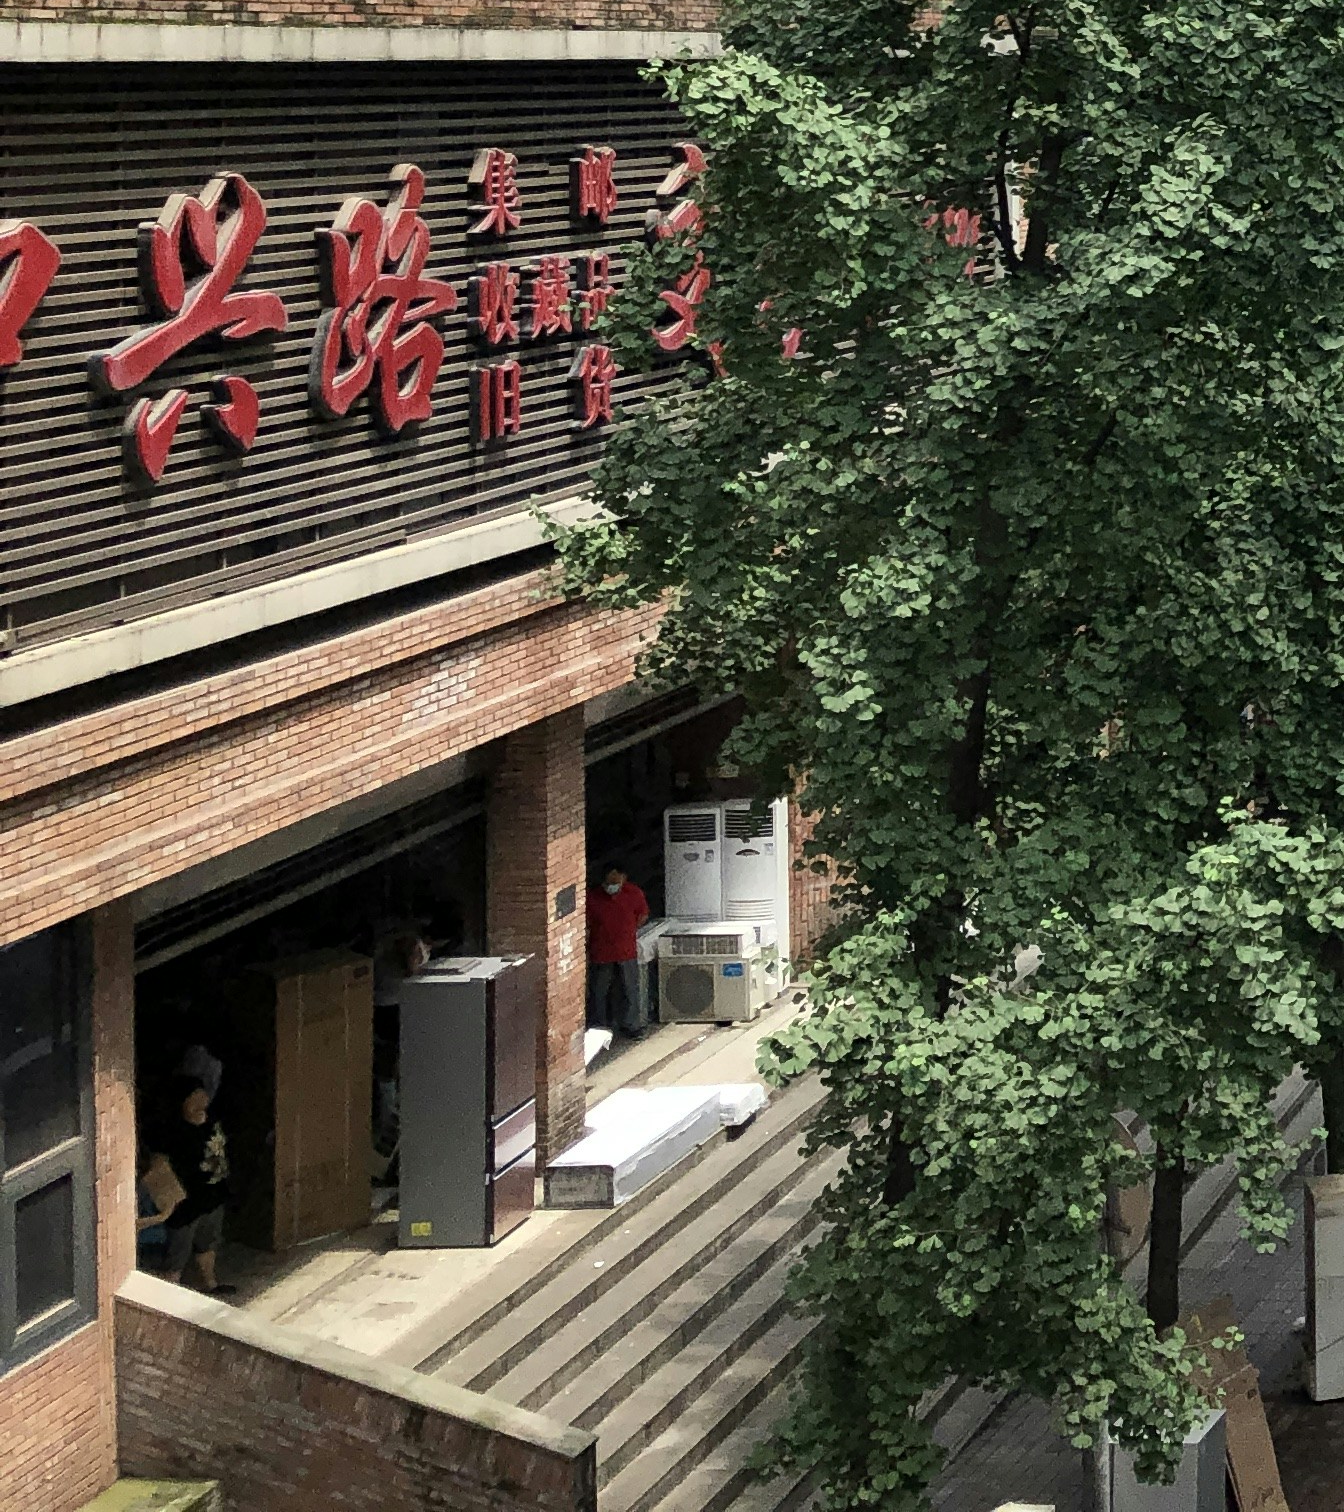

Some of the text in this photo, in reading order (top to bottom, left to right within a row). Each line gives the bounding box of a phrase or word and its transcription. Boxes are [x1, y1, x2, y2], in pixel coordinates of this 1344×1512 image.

[468, 144, 618, 234] 集邮
[0, 163, 458, 483] 兴路
[468, 252, 615, 345] 收藏品
[470, 343, 618, 439] 旧货
